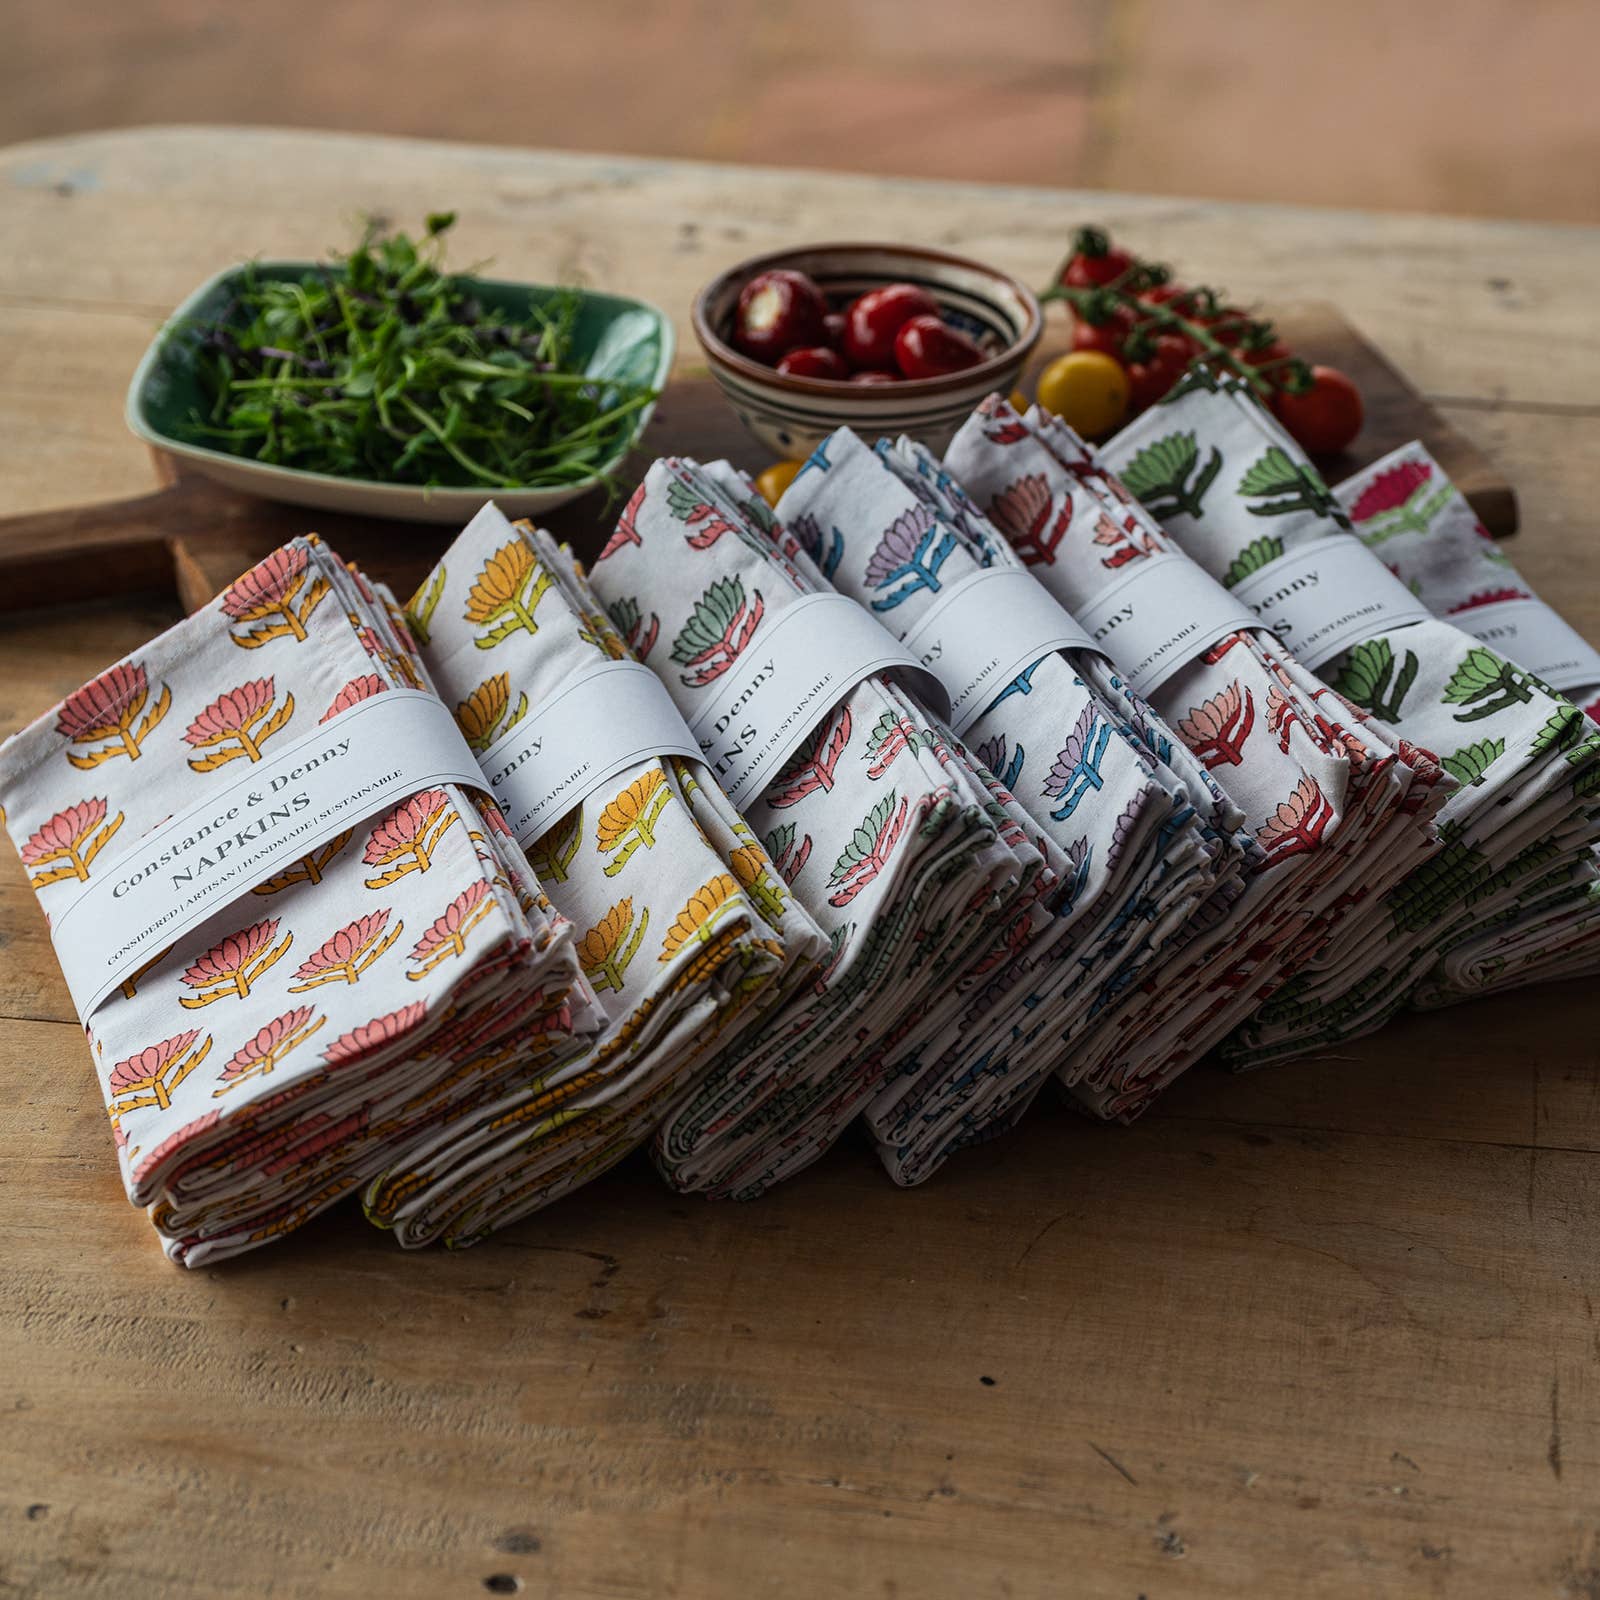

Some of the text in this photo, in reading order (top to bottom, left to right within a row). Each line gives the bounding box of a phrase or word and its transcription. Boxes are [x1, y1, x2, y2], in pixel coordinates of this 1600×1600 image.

[1093, 603, 1134, 641] nny
[713, 658, 776, 735] Denny
[769, 673, 833, 745] SUSTAINABLE
[491, 736, 543, 787] enny
[712, 724, 757, 777] INS
[112, 738, 351, 898] Constance & Denny
[520, 761, 591, 826] SUSTAINABLE
[107, 769, 403, 966] CONSIDERED ARTISAN HANDMADE SUSTAINABLE
[170, 792, 311, 892] NAPKINS
